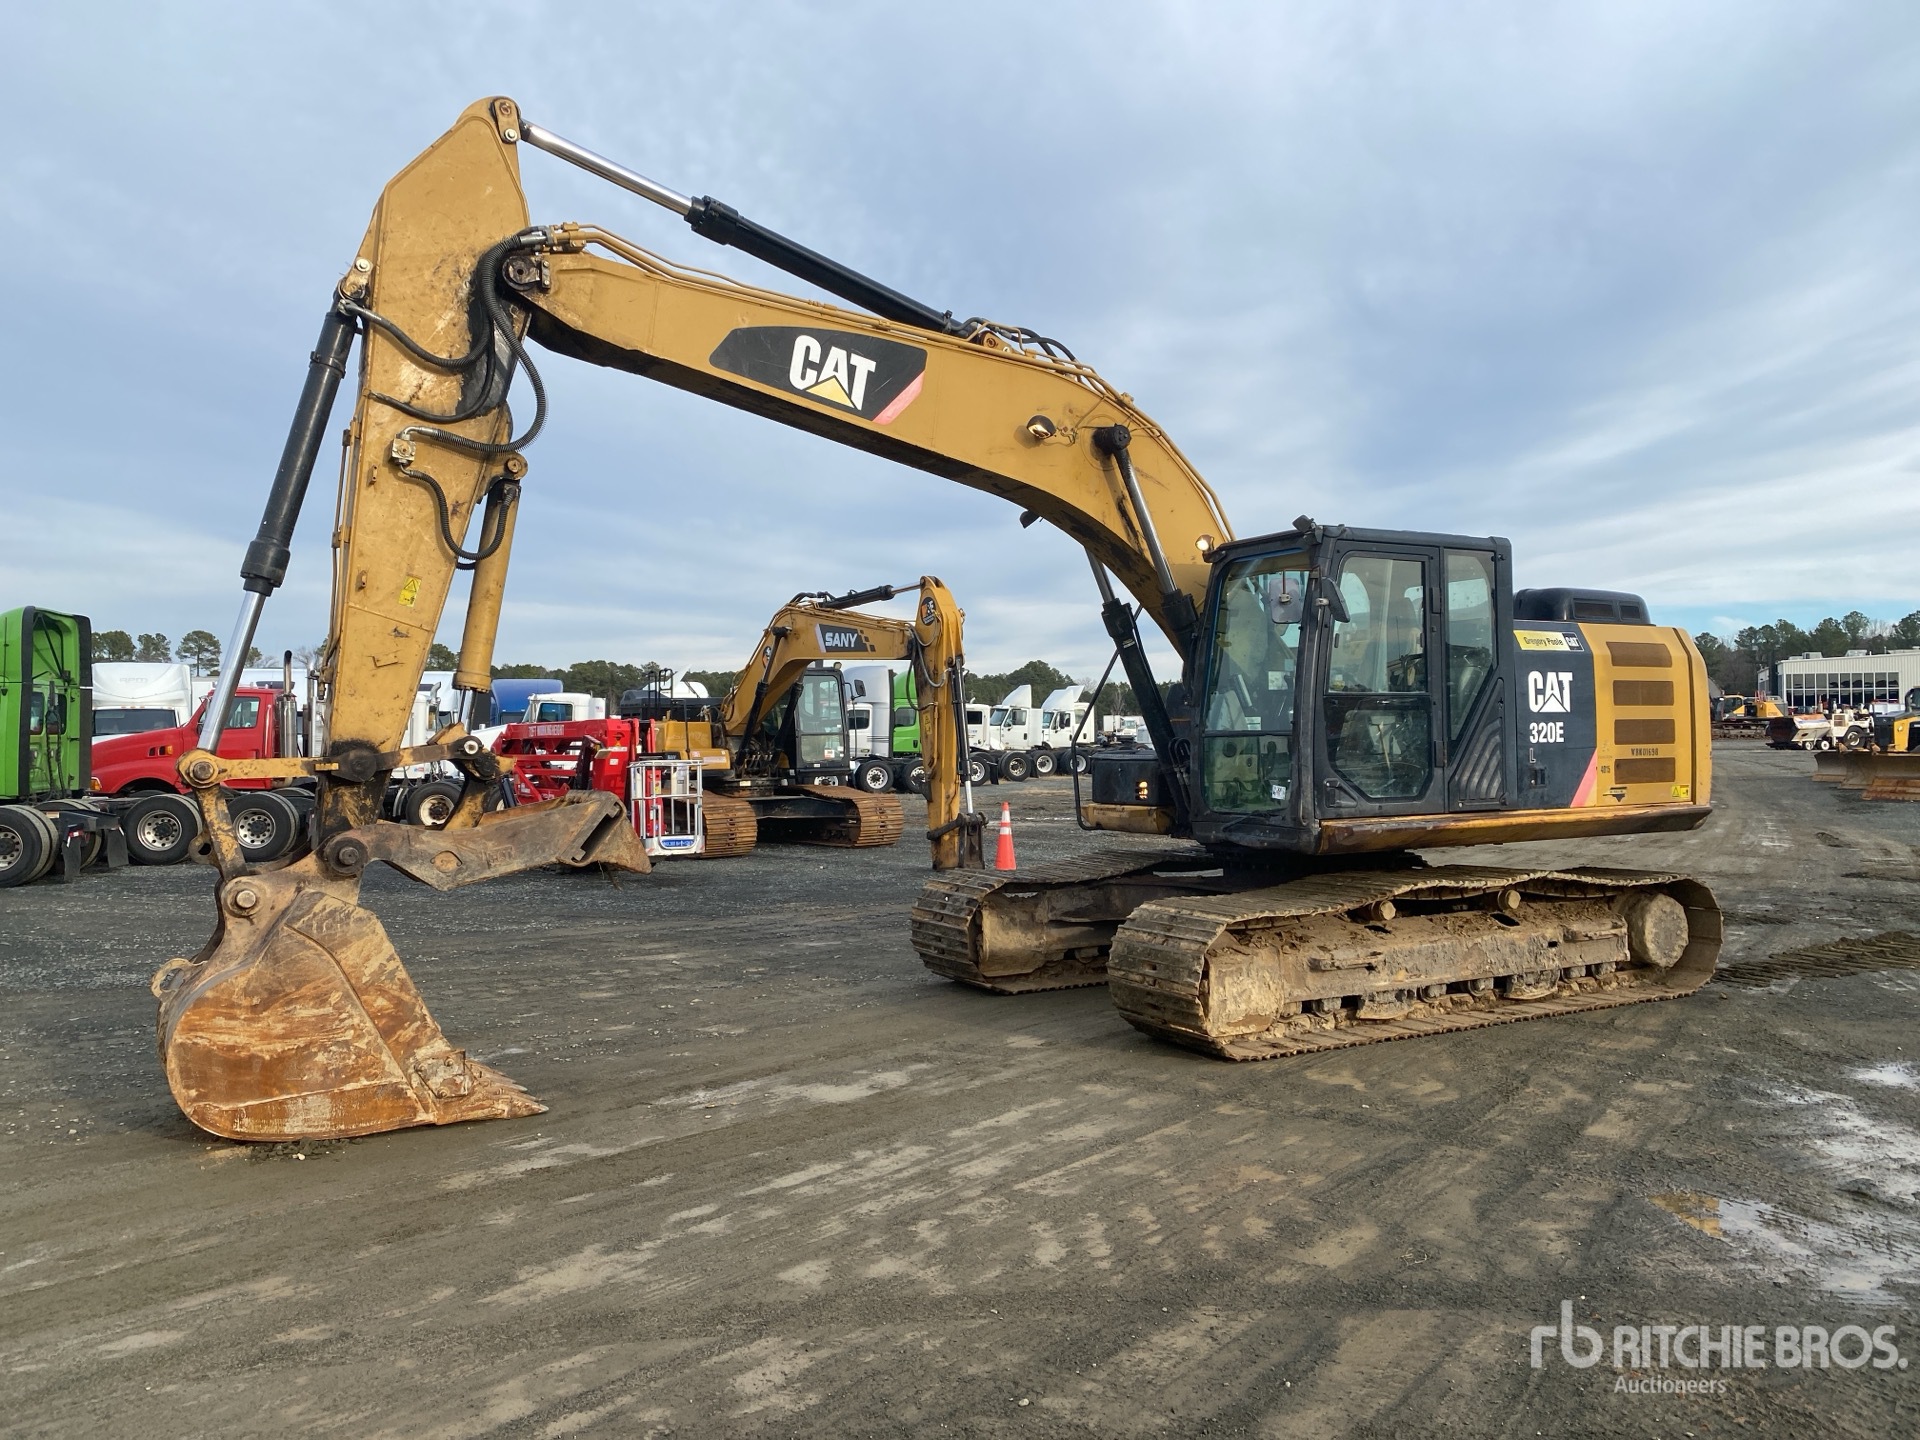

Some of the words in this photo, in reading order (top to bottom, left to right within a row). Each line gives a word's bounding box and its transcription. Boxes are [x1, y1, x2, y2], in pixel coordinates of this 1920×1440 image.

[789, 334, 877, 411] CAT
[825, 632, 858, 648] SANY
[1523, 637, 1547, 646] Gregory
[1546, 638, 1564, 646] Poole
[1565, 636, 1580, 647] CAT
[1528, 670, 1573, 713] CAT
[1529, 722, 1564, 743] 320E
